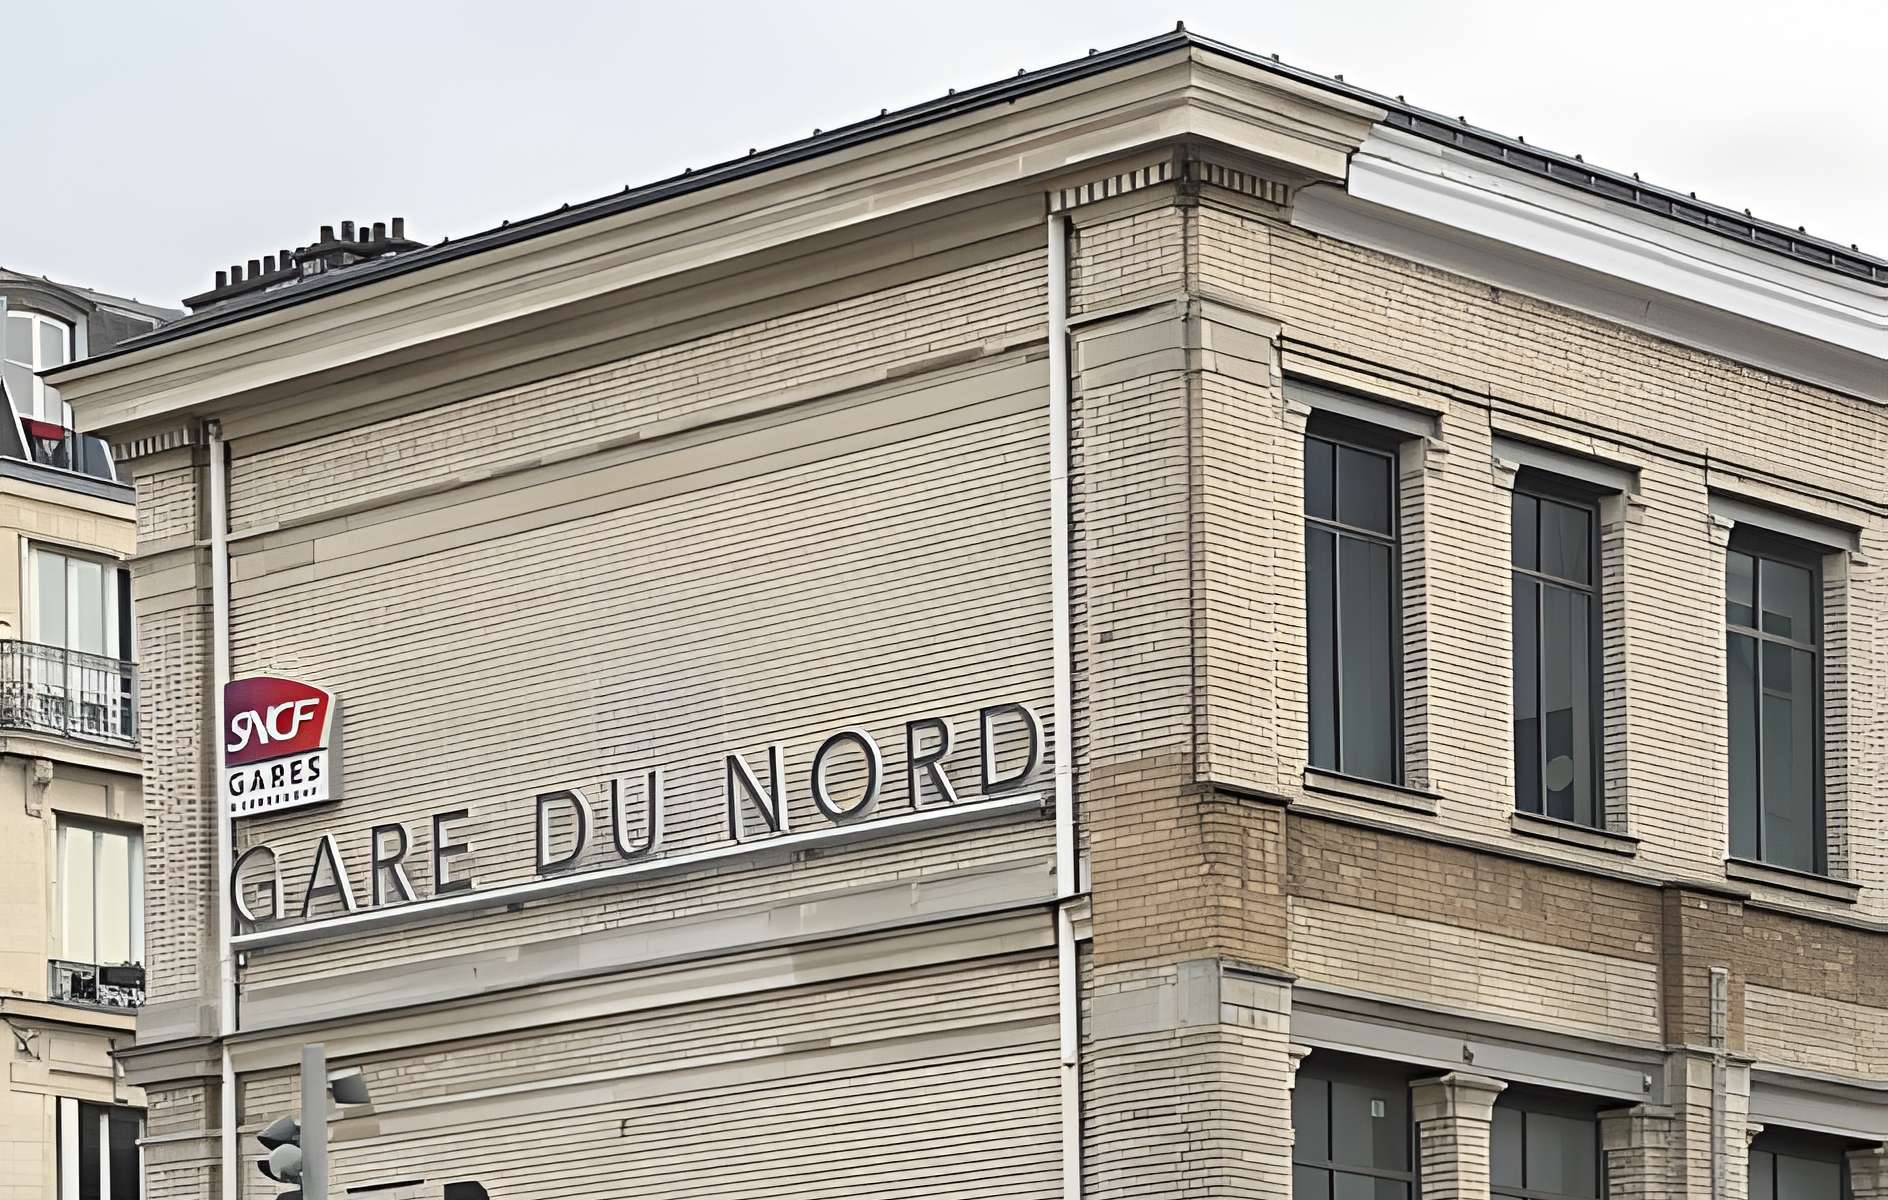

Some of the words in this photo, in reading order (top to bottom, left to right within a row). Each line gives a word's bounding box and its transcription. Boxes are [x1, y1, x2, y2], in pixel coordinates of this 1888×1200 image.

[227, 698, 320, 752] SNCF
[229, 756, 320, 797] GARES
[231, 808, 477, 922] GARE
[536, 766, 665, 876] DU
[725, 702, 1044, 841] NORD
